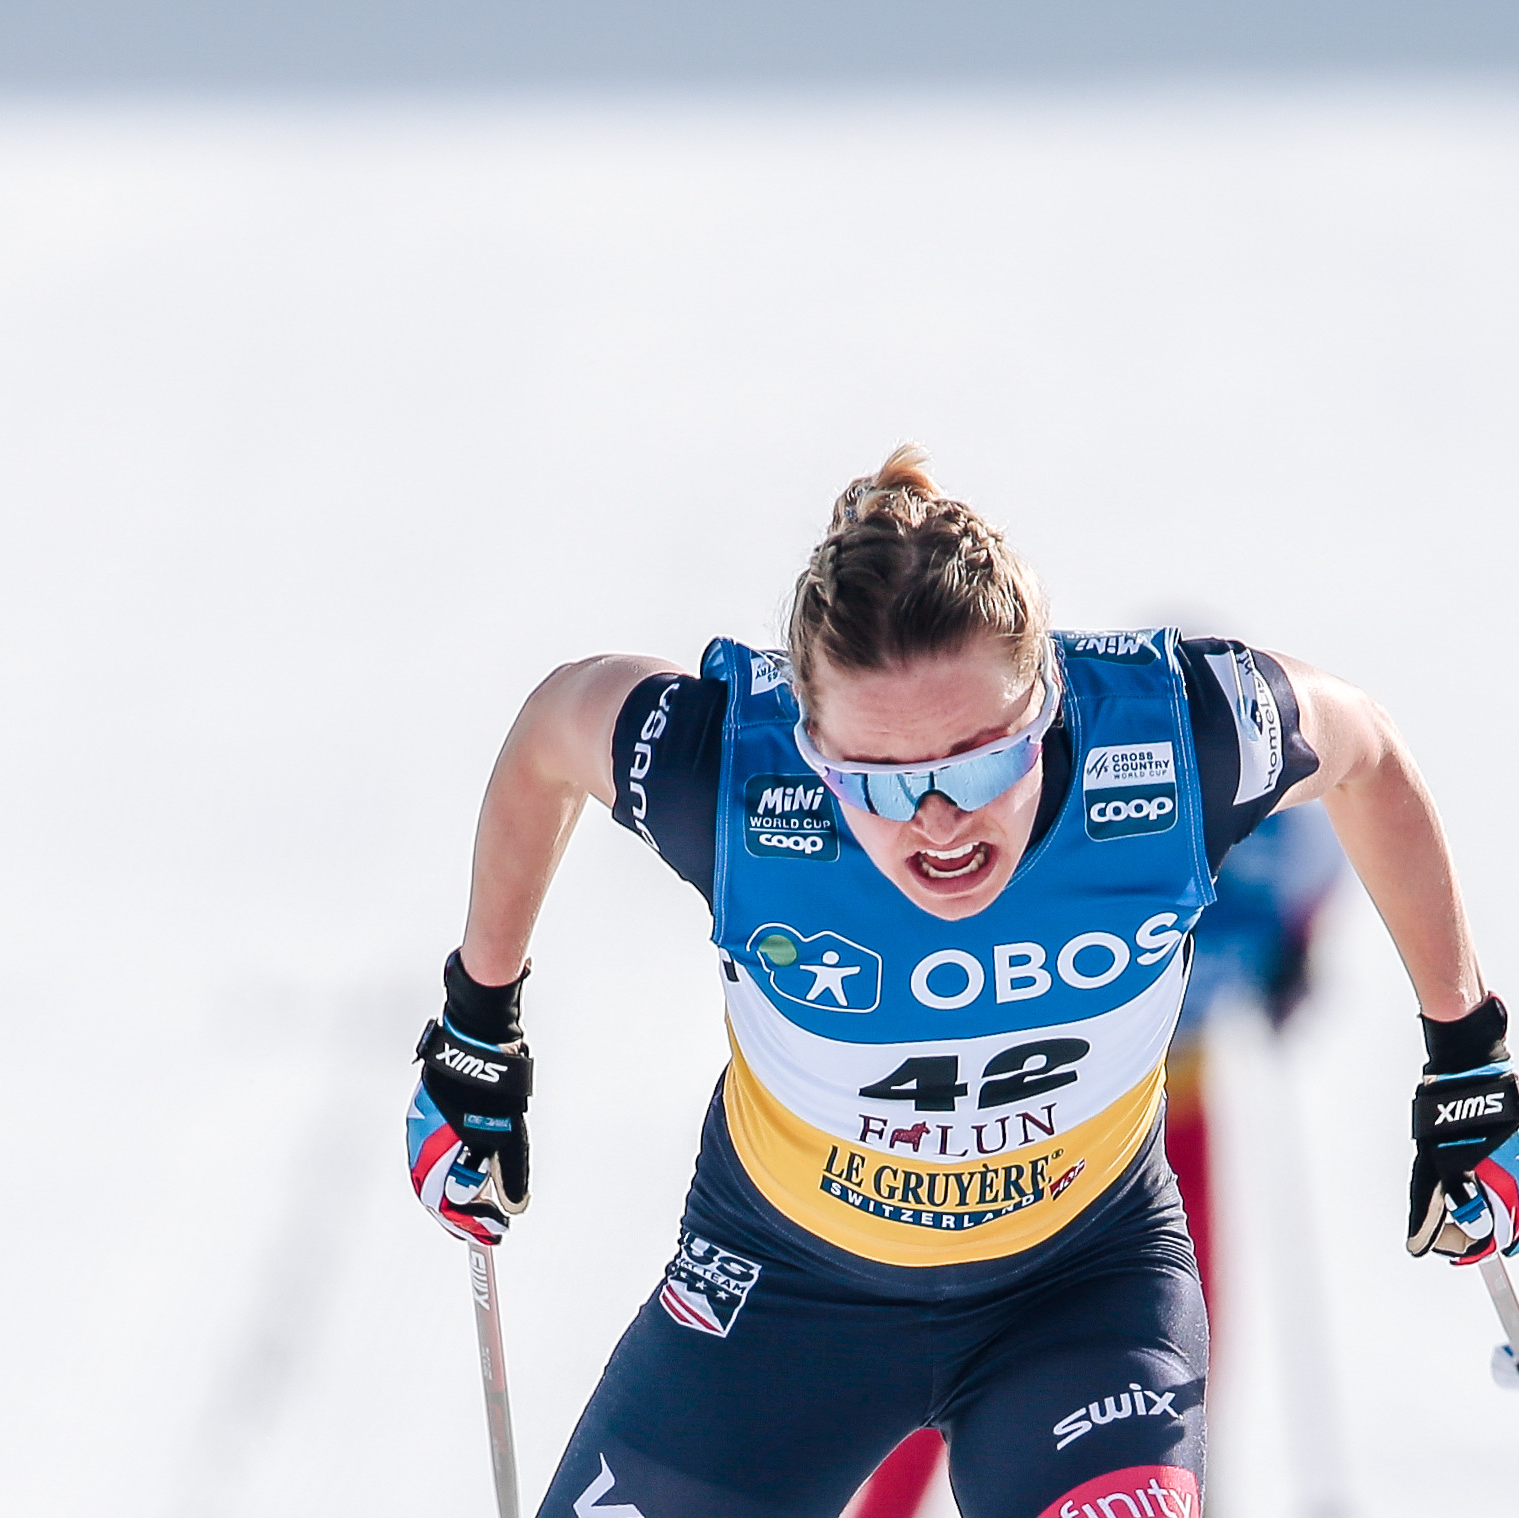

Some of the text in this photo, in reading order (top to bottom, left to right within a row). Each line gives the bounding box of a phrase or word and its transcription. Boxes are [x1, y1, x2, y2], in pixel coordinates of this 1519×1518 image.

[1111, 751, 1154, 763] CROSS
[1112, 759, 1170, 773] COUNTRY
[1113, 769, 1168, 780] WORLD CUP
[749, 816, 831, 830] WORLD CUP
[1090, 796, 1174, 823] coop
[759, 833, 824, 855] coop
[910, 911, 1182, 1011] OBOS
[858, 1037, 1091, 1113] 42
[857, 1102, 1057, 1158] FLUN
[822, 1145, 866, 1189] LE
[683, 1233, 756, 1283] US
[702, 1267, 748, 1297] TEAM
